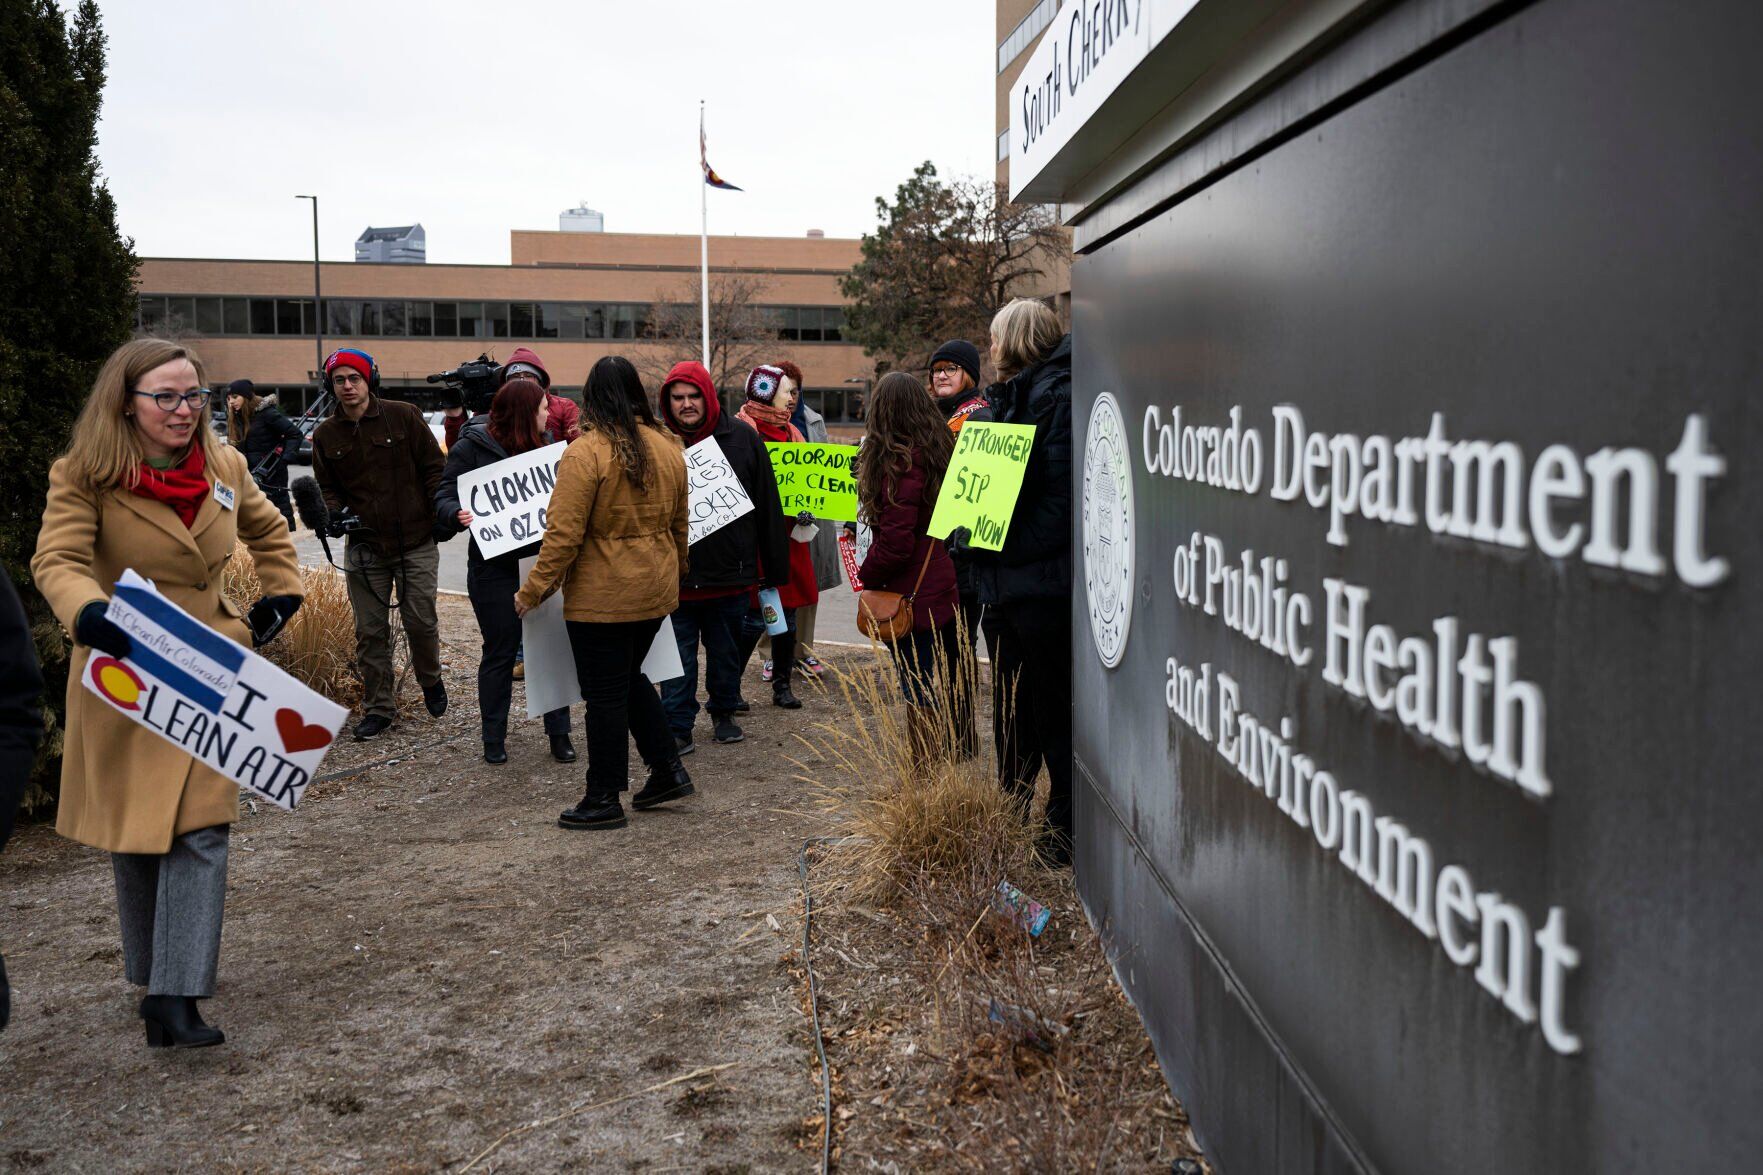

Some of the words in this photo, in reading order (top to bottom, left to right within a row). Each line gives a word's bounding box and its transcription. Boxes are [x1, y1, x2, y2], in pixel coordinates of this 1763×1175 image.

[1022, 41, 1061, 154] SOUTH
[959, 427, 1032, 464] STRONGER
[470, 460, 560, 517] CHOKIN
[774, 470, 796, 486] OR
[806, 473, 857, 495] CLEAN
[954, 466, 991, 504] SIP
[1103, 409, 1129, 542] COLORADO
[1143, 404, 1261, 495] Colorado
[1272, 403, 1729, 587] Department
[479, 523, 504, 542] ON
[510, 507, 548, 541] OZO
[781, 493, 825, 510] IR!!!
[973, 514, 1006, 547] NOW
[1098, 619, 1113, 650] 1876
[1173, 532, 1202, 604] of
[1203, 535, 1312, 666] Public
[1322, 578, 1552, 797] Health
[222, 681, 268, 732] I
[236, 746, 309, 809] AIR
[1165, 656, 1212, 741] and
[1217, 672, 1581, 1054] Environment
